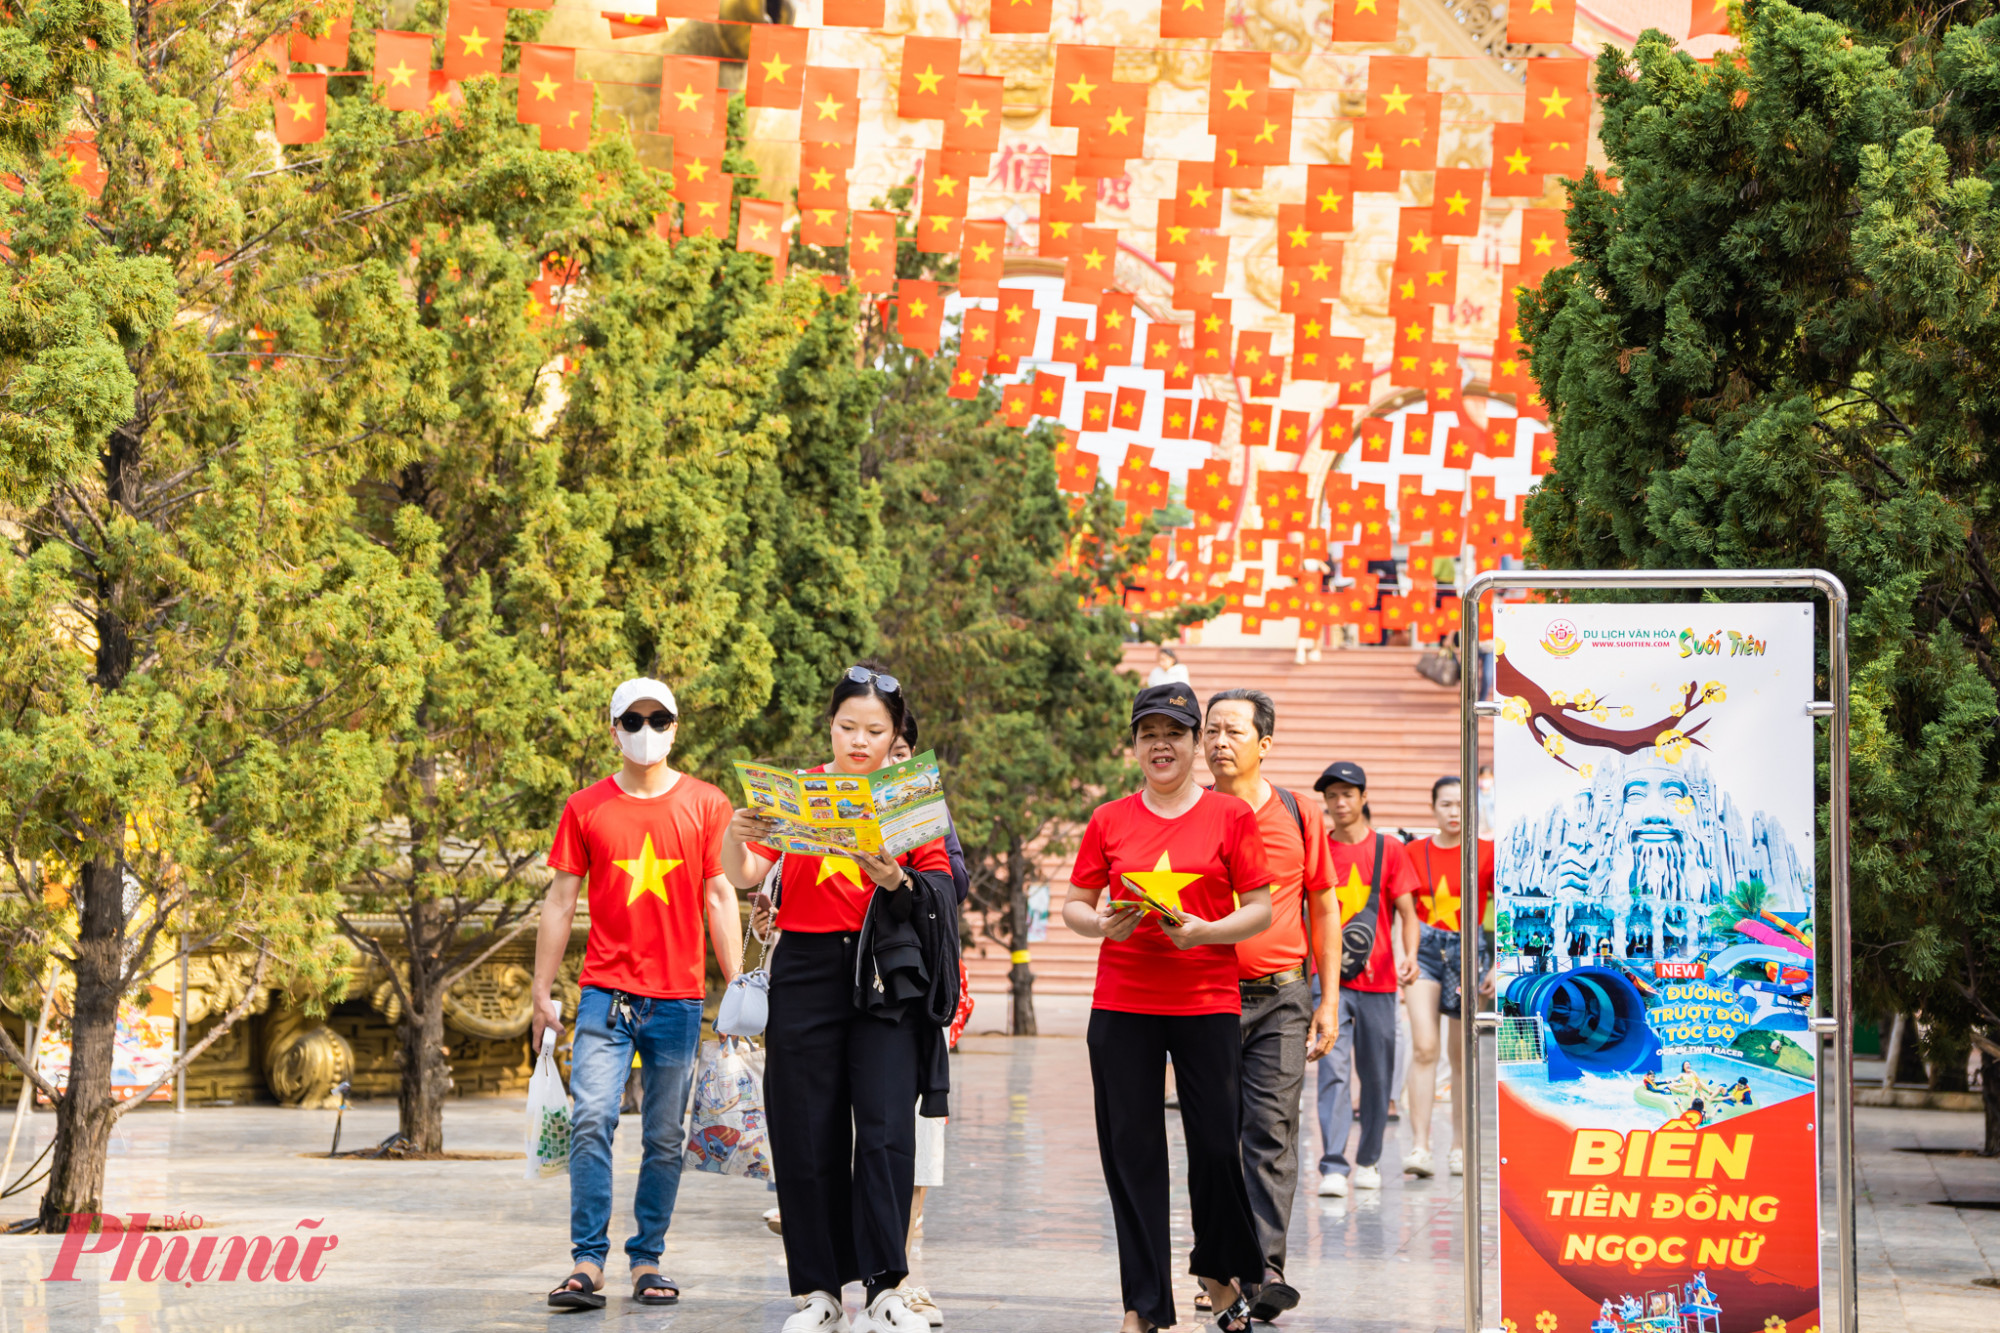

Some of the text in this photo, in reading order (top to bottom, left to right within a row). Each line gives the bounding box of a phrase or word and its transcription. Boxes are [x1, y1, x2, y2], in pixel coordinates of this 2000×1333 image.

[1583, 628, 1677, 641] DU LỊCH VĂN HÓA
[1592, 640, 1670, 648] WWW.SUOITIEN.COM
[1662, 964, 1698, 977] NEW
[1666, 985, 1734, 1003] ĐƯỜNG
[1651, 1005, 1750, 1025] TRƯỢT ĐÔI
[1666, 1022, 1735, 1042] TỐC ĐỘ
[1656, 1046, 1743, 1057] OCEAN TWIN RACER
[1568, 1111, 1754, 1180] BIỂN
[1546, 1184, 1780, 1223] TIÊN ĐỒNG
[1563, 1231, 1767, 1270] NGỌC NỮ
